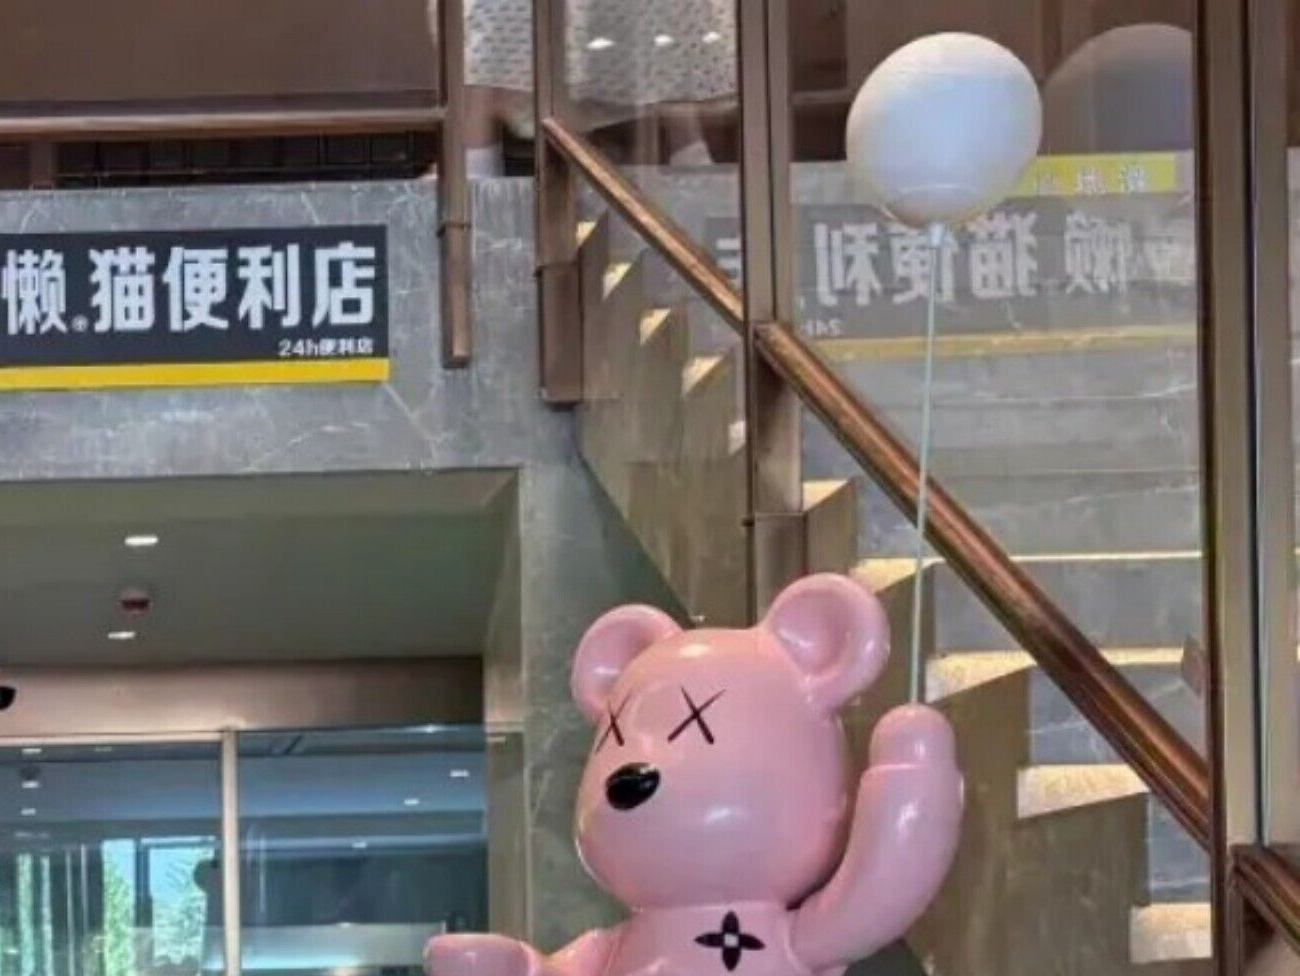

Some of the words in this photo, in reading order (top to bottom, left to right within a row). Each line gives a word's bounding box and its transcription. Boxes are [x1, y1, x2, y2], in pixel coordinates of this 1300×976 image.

[1, 241, 376, 336] 懒猫便利店
[278, 338, 374, 358] 24h便利店
